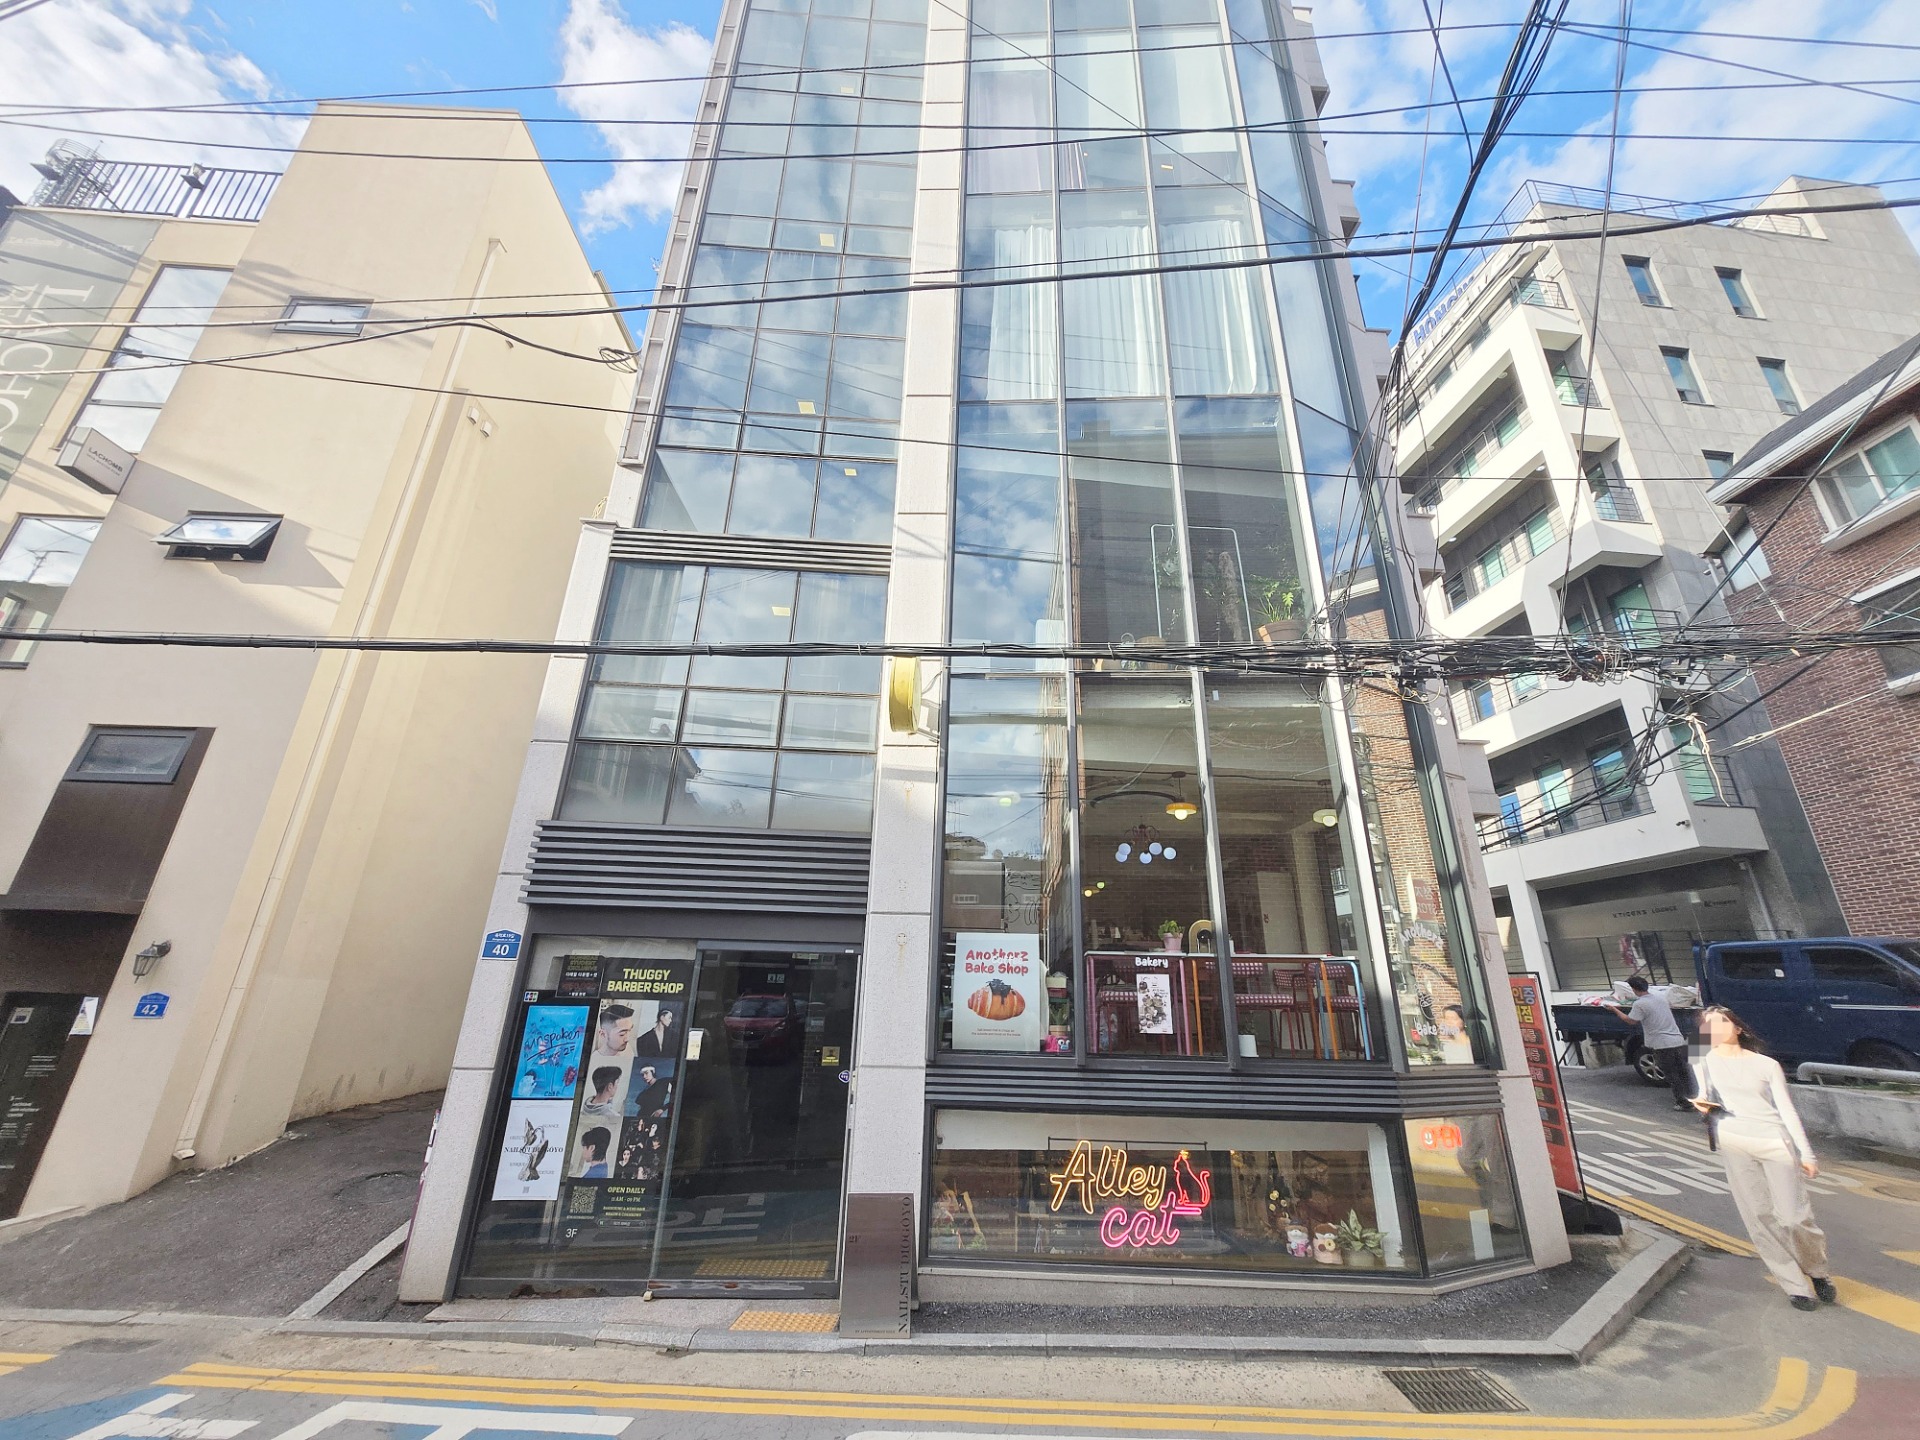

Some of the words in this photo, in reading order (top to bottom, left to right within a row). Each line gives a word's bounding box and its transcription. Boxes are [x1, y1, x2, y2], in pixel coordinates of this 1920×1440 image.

[492, 944, 510, 956] 40
[965, 961, 995, 974] Bake
[997, 962, 1029, 976] Shop
[1135, 957, 1169, 968] Bakery
[623, 968, 671, 981] THUGGY
[606, 981, 652, 993] BARBER
[652, 982, 684, 994] SHOP
[141, 1004, 159, 1015] 42
[1414, 1017, 1438, 1037] Bake
[1050, 1139, 1167, 1215] Alley
[607, 1186, 625, 1194] OPEN
[565, 1228, 578, 1238] 3F
